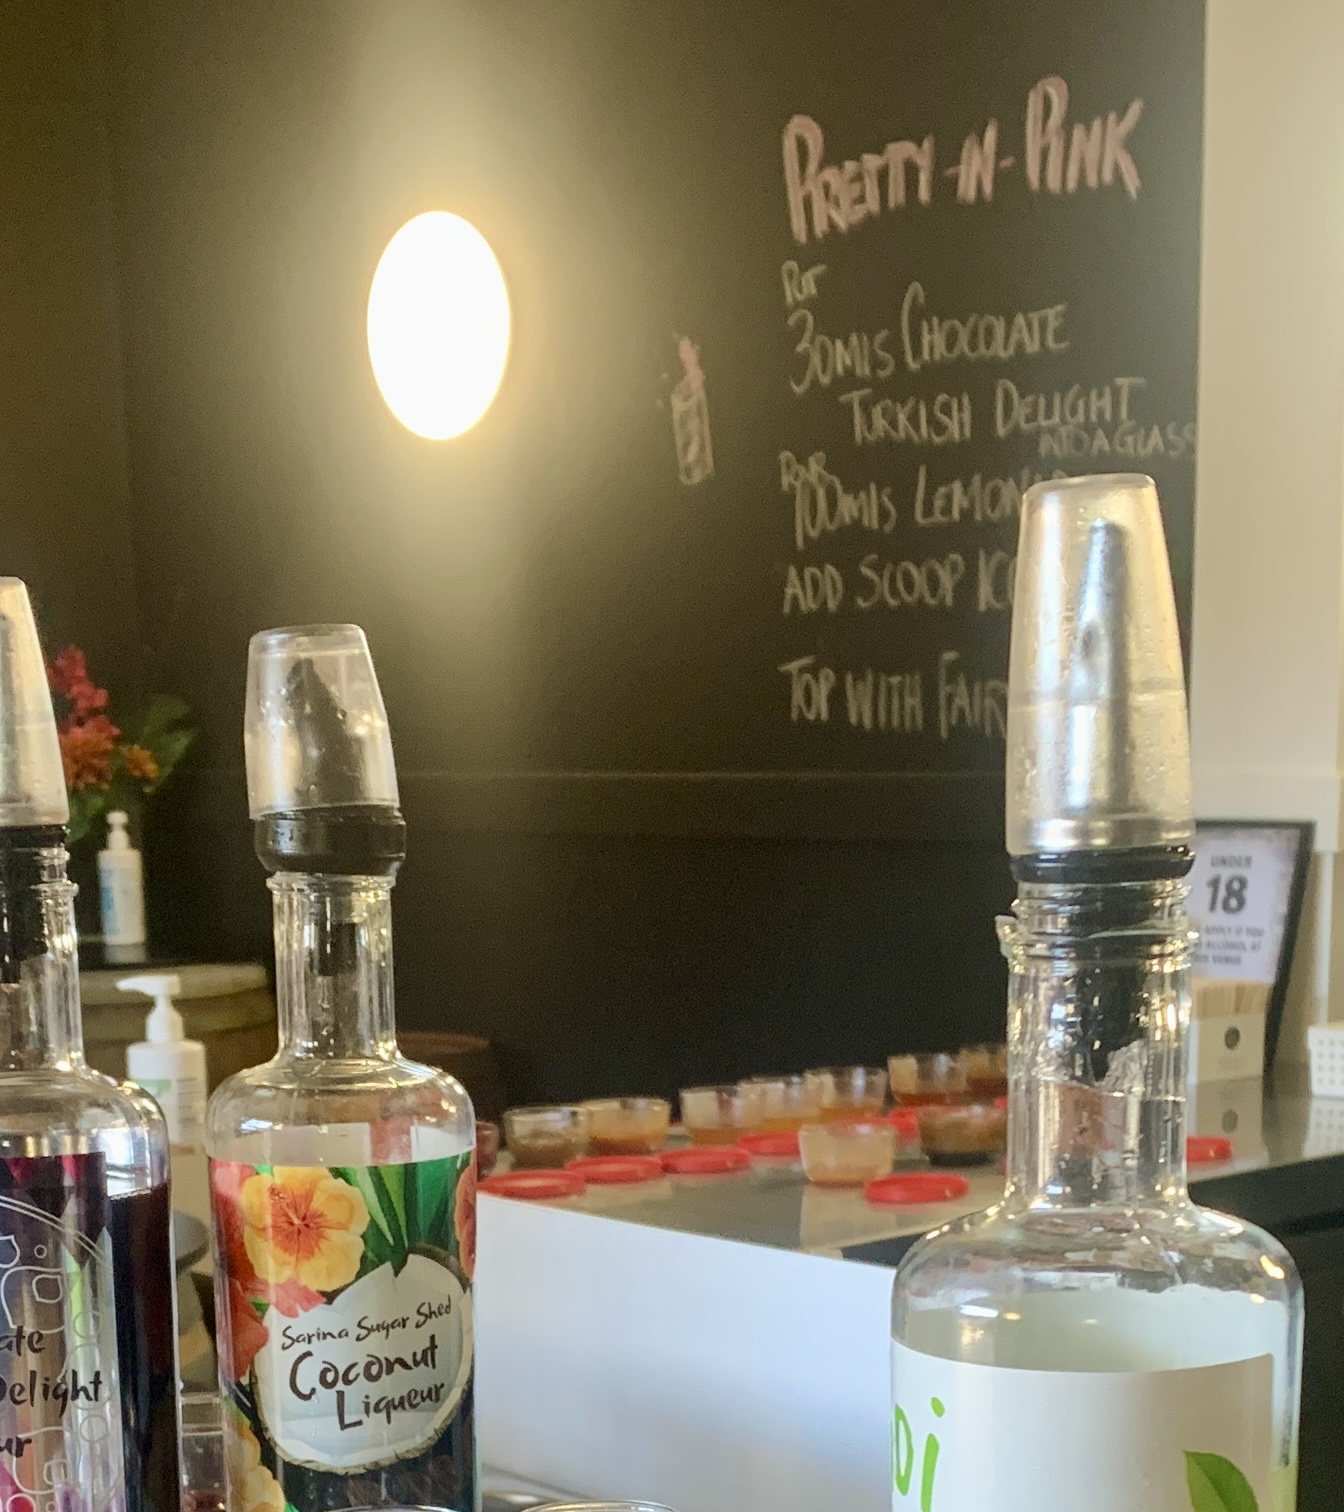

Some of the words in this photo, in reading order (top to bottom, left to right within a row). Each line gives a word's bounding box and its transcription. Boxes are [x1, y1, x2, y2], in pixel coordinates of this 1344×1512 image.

[839, 388, 972, 446] TURKISH
[996, 378, 1147, 439] DELIGHT
[783, 563, 843, 617] ADD
[856, 554, 965, 609] SCOOP
[777, 655, 835, 721] TOP
[845, 667, 924, 733] WITH
[938, 651, 1008, 739] FAIR
[1206, 873, 1249, 914] 18
[281, 1325, 349, 1351] Sarina
[356, 1316, 409, 1342] Sugar
[415, 1294, 452, 1329] Shed
[289, 1334, 438, 1401] Coconut
[335, 1382, 445, 1431] Liqueur
